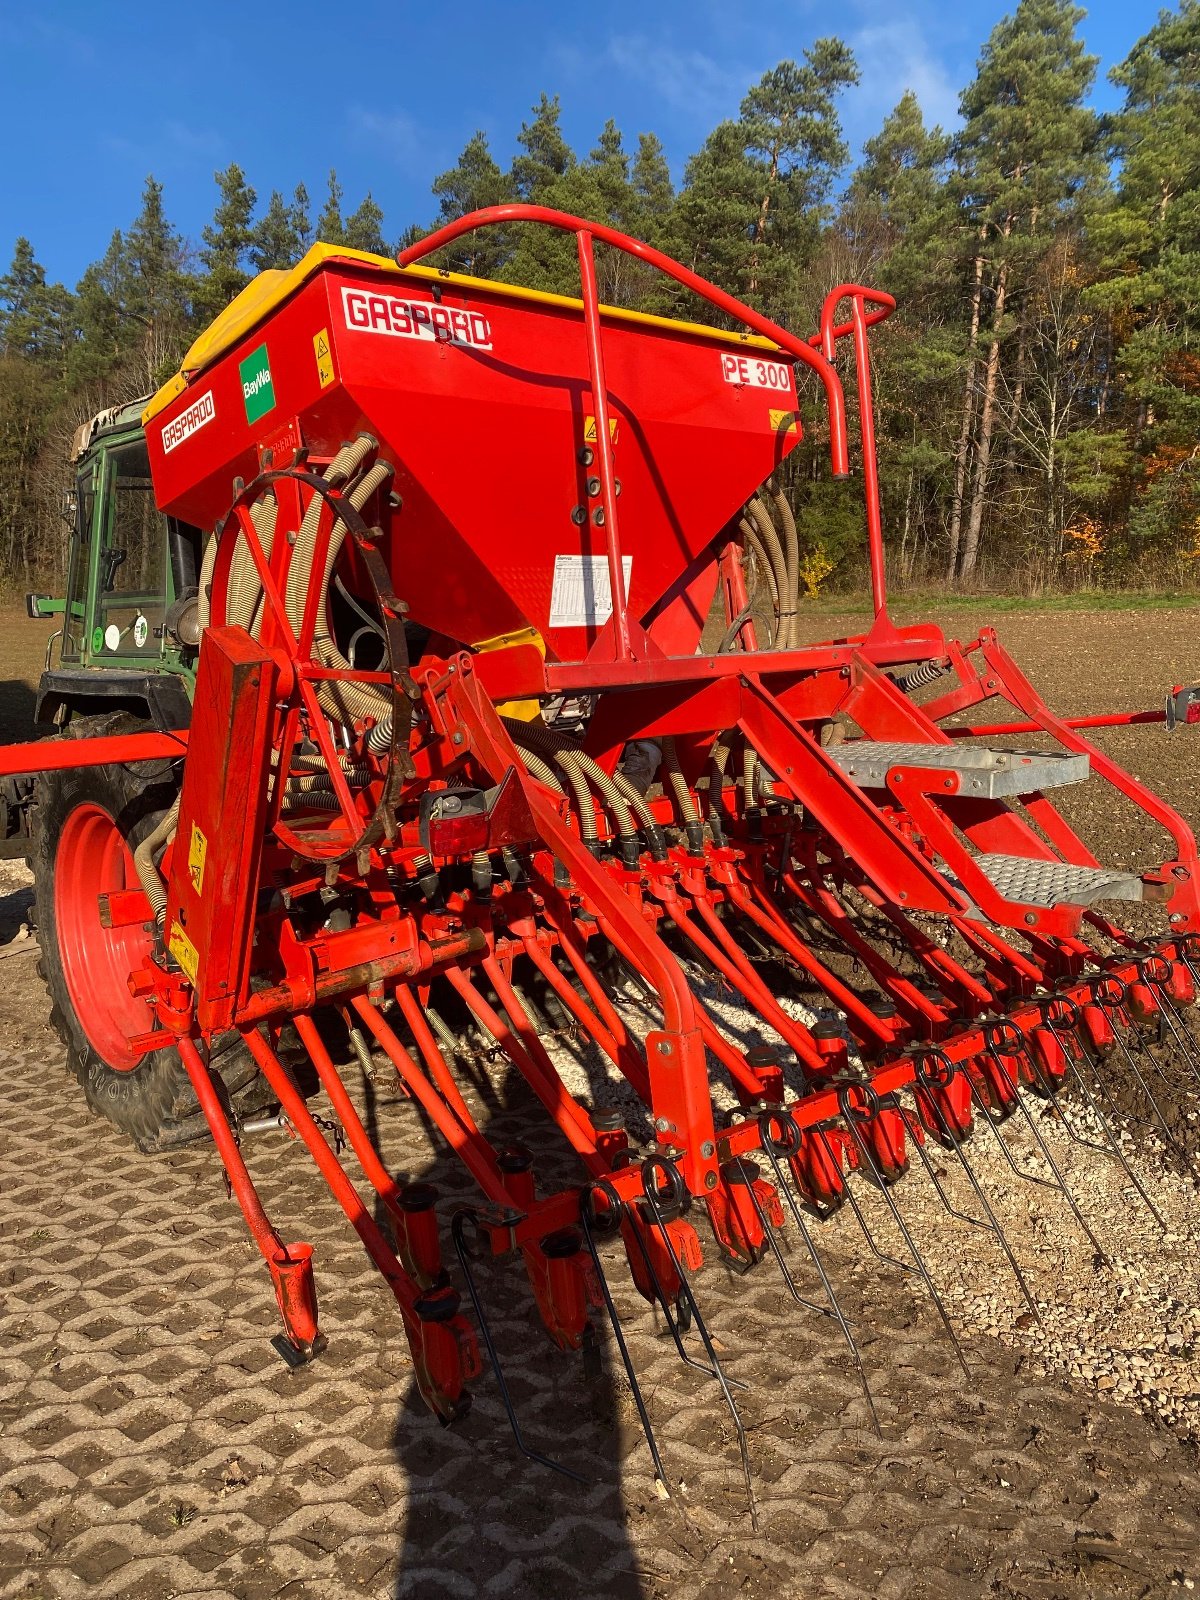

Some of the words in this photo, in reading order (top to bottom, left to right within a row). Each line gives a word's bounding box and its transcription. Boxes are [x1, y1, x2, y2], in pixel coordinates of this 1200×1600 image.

[243, 368, 271, 399] BayWa
[723, 356, 750, 384] PE
[756, 362, 789, 390] 300
[163, 395, 213, 450] GASPARDO
